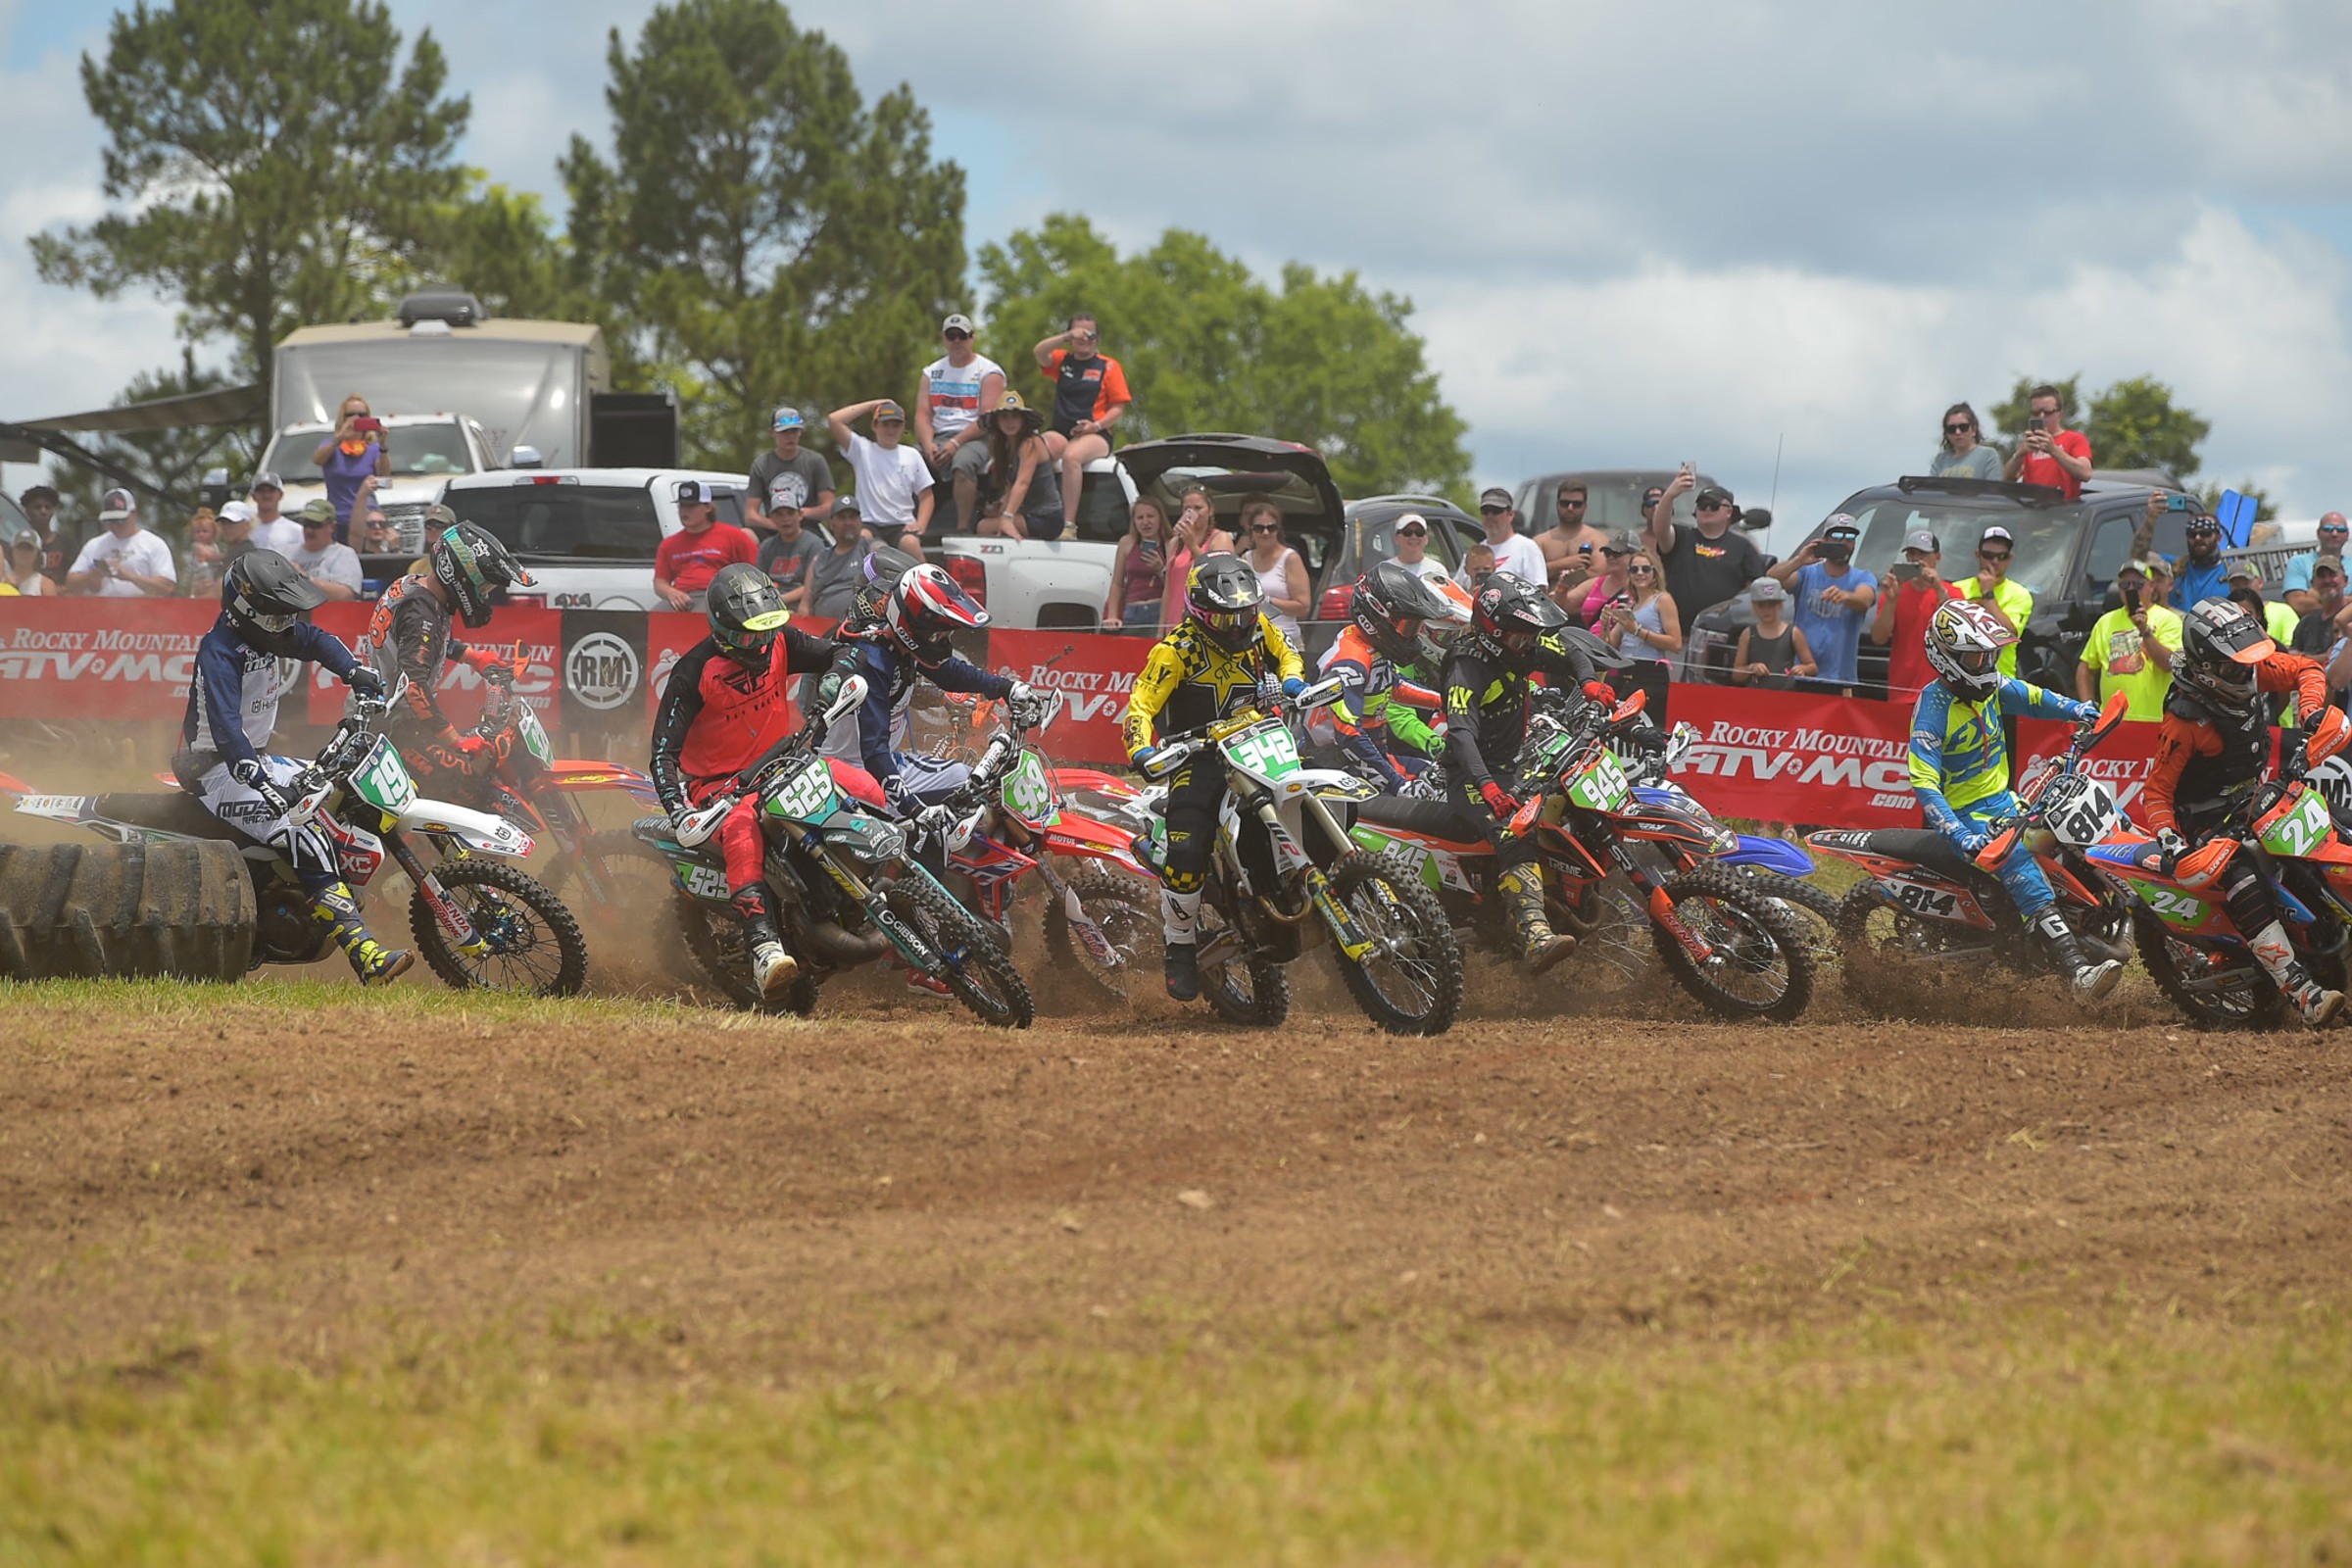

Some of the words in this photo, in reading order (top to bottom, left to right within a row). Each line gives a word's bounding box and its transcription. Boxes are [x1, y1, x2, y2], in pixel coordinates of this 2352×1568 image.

[12, 628, 89, 651] ROCKY
[898, 626, 918, 650] 990
[580, 656, 624, 687] RM
[1028, 665, 1103, 691] ROCKY
[1707, 721, 1789, 747] ROCKY
[1237, 730, 1300, 774] 342
[2075, 758, 2139, 779] OCKY
[370, 750, 408, 805] 19
[777, 760, 832, 819] 525
[1012, 759, 1049, 819] 99
[1582, 756, 1628, 811] 945
[2067, 786, 2115, 843] 814
[2281, 798, 2330, 857] 24
[1049, 834, 1076, 845] MOTUL
[688, 866, 730, 900] 525
[1899, 883, 1957, 916] 814
[429, 899, 463, 939] BRAKING
[2150, 891, 2200, 919] 24
[893, 919, 929, 956] GIBSON
[1662, 912, 1703, 958] KENDA
